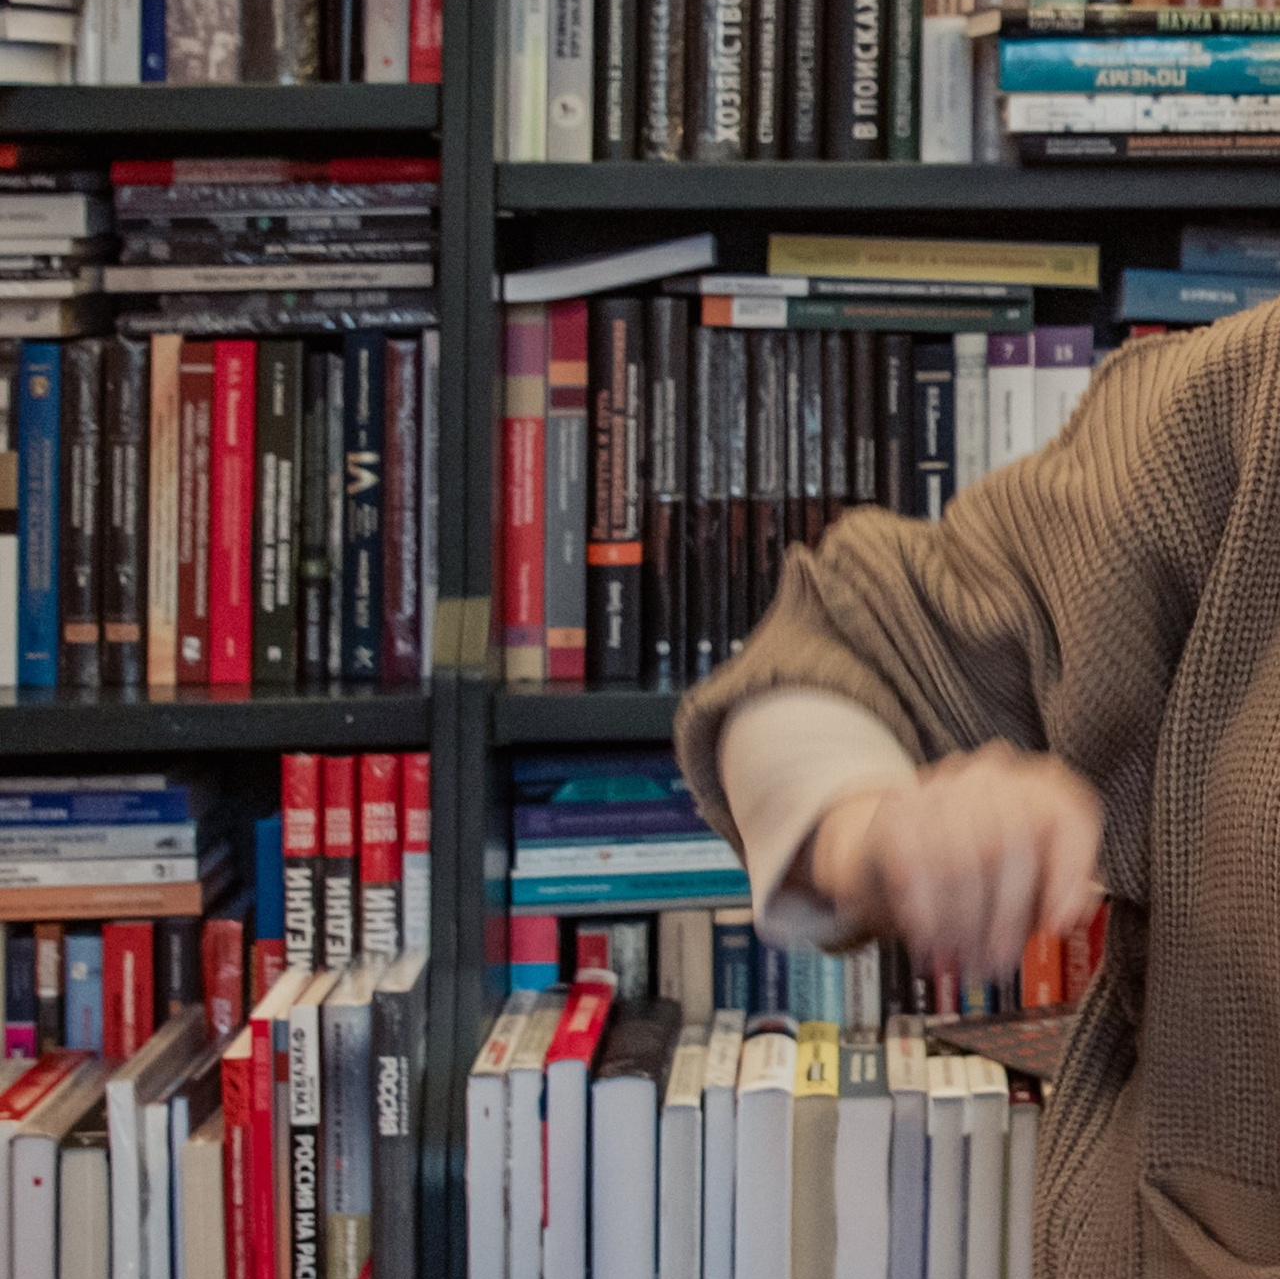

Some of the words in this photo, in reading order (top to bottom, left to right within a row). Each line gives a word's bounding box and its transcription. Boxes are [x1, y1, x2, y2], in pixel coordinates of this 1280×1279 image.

[1095, 68, 1187, 86] ПОЧЕМУ
[855, 122, 878, 139] В
[292, 1028, 307, 1117] ФУКУЯМА
[378, 1056, 399, 1136] РОССИЯ
[295, 1134, 315, 1210] РОССИЯ
[297, 1214, 316, 1240] НА
